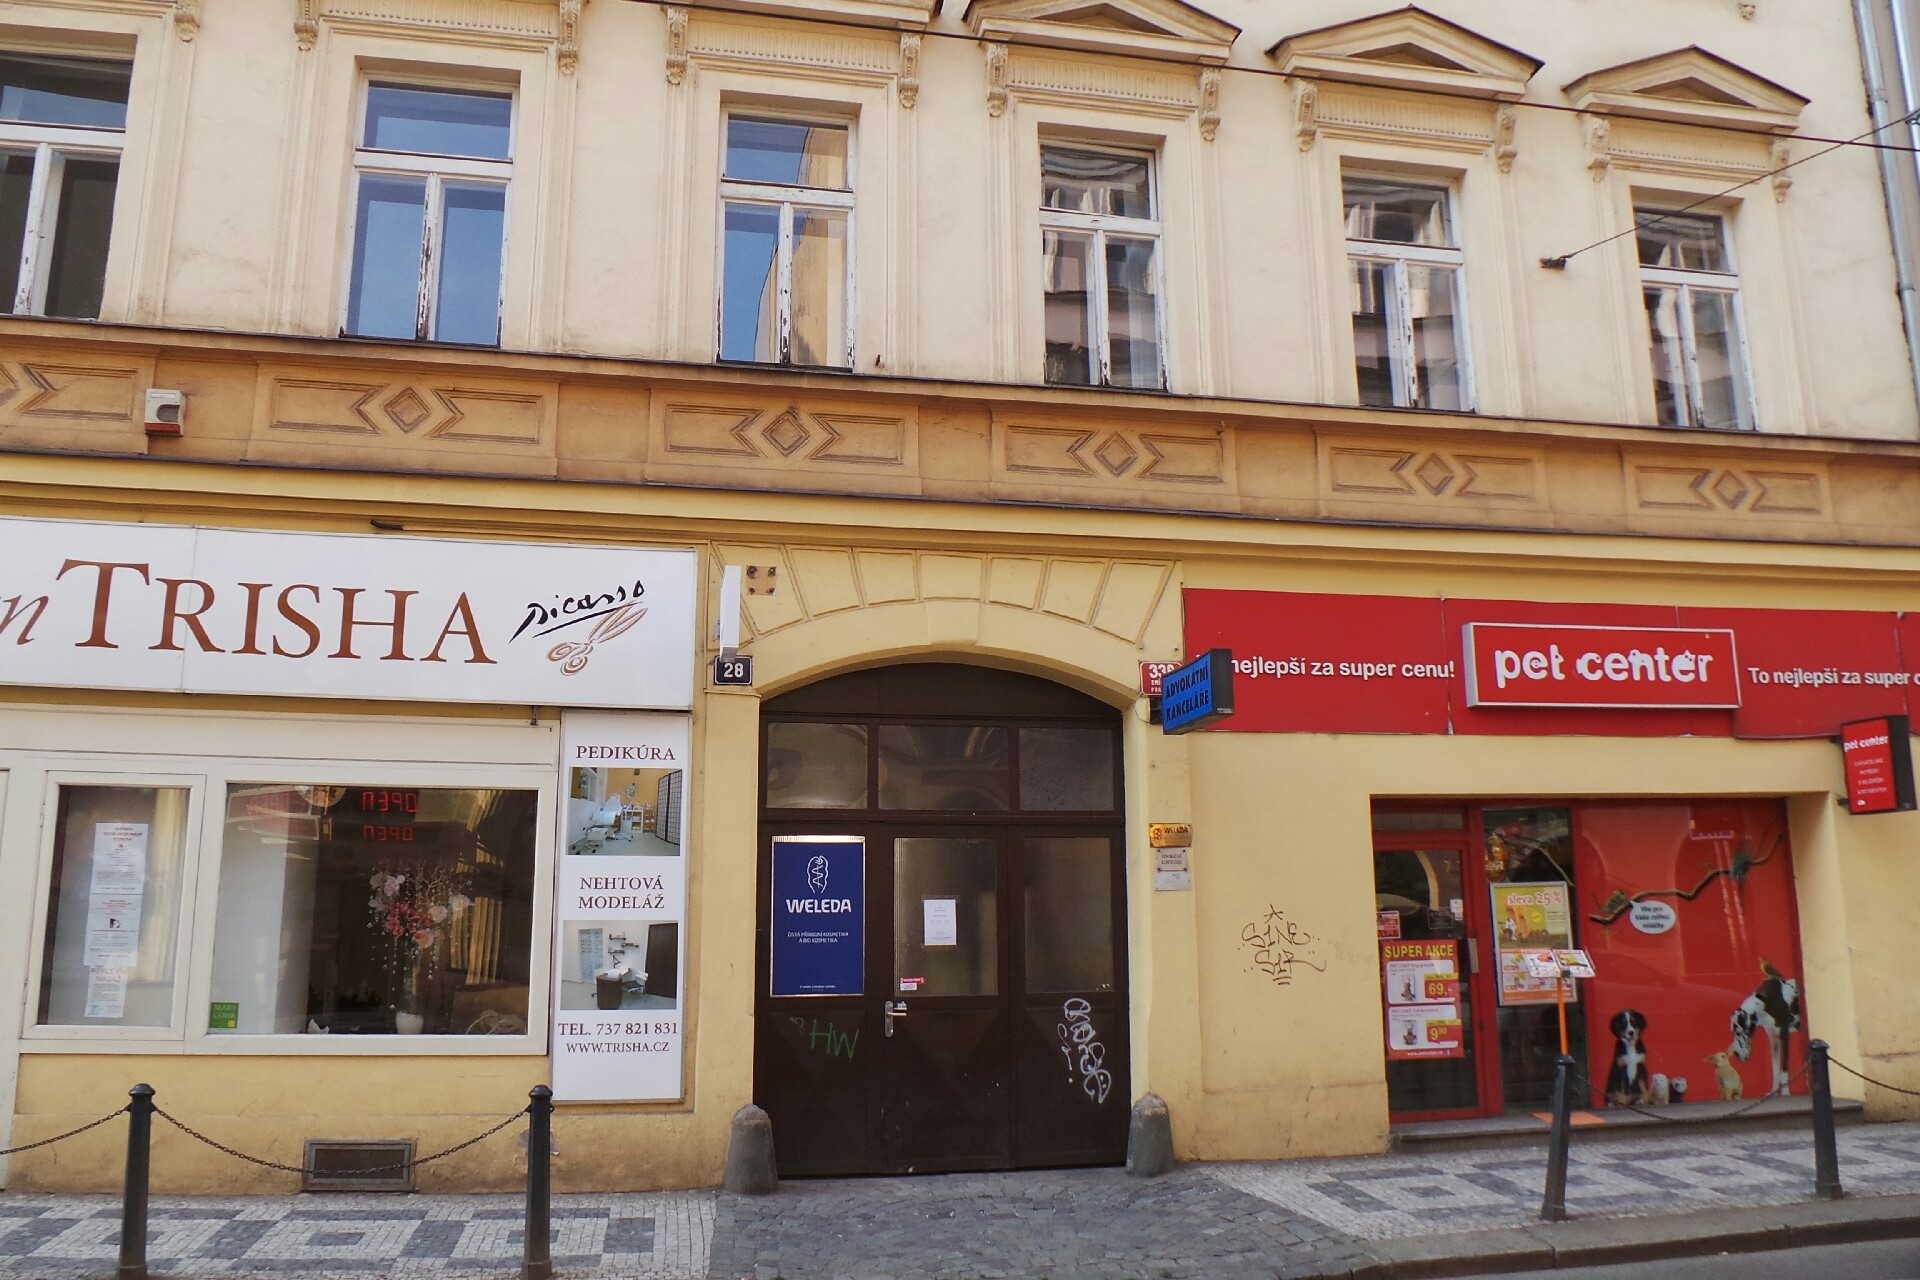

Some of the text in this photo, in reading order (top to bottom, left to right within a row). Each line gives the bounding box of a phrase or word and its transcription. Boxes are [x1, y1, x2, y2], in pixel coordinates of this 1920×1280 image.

[56, 558, 498, 665] TRISHA
[723, 662, 744, 678] 28
[1231, 655, 1455, 681] nejlepší za super cenu!
[1494, 644, 1713, 689] pet center
[1166, 662, 1209, 699] ADVOKÁTNÍ
[1748, 667, 1770, 684] To
[1841, 671, 1861, 684] za
[1864, 672, 1910, 688] super
[1166, 689, 1209, 721] KANCELÁŘE
[576, 744, 676, 761] PEDIKÚRA
[1843, 735, 1889, 753] pet center
[579, 874, 664, 891] NEHTOVÁ
[578, 893, 665, 909] MODELÁŽ
[785, 899, 852, 914] WELEDA
[1507, 894, 1534, 905] sleva
[1535, 892, 1551, 906] 25
[1385, 944, 1454, 958] SUPER AKCE
[558, 1022, 678, 1036] TEL. 737 821 831
[566, 1041, 670, 1054] WWW.TRISHA.CZ
